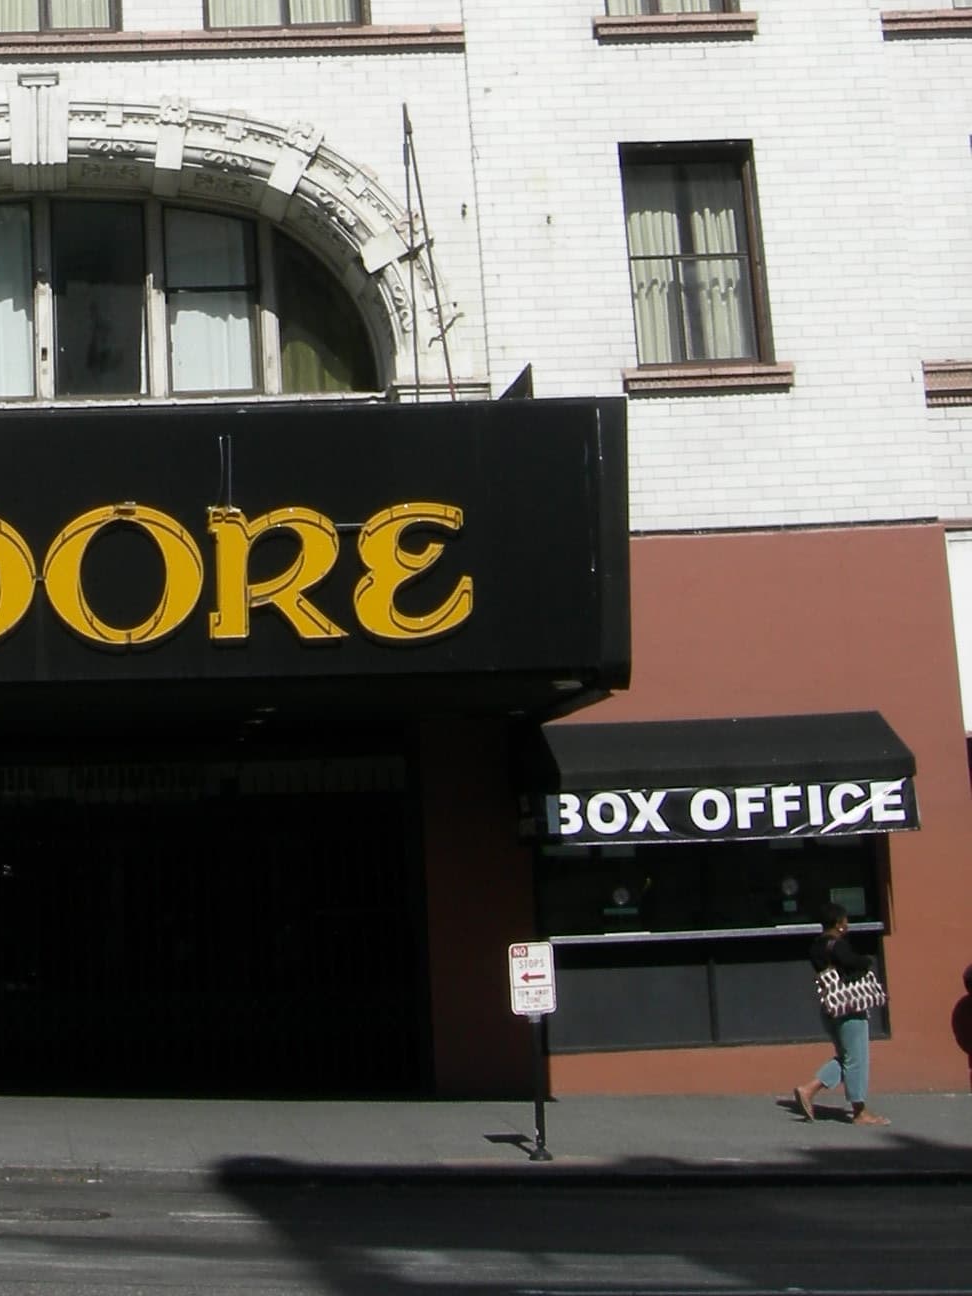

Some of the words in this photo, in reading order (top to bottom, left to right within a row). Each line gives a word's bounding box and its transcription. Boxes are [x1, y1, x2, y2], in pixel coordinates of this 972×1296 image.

[547, 790, 671, 836] BOX
[689, 778, 907, 832] OFFICE
[513, 947, 527, 957] NO
